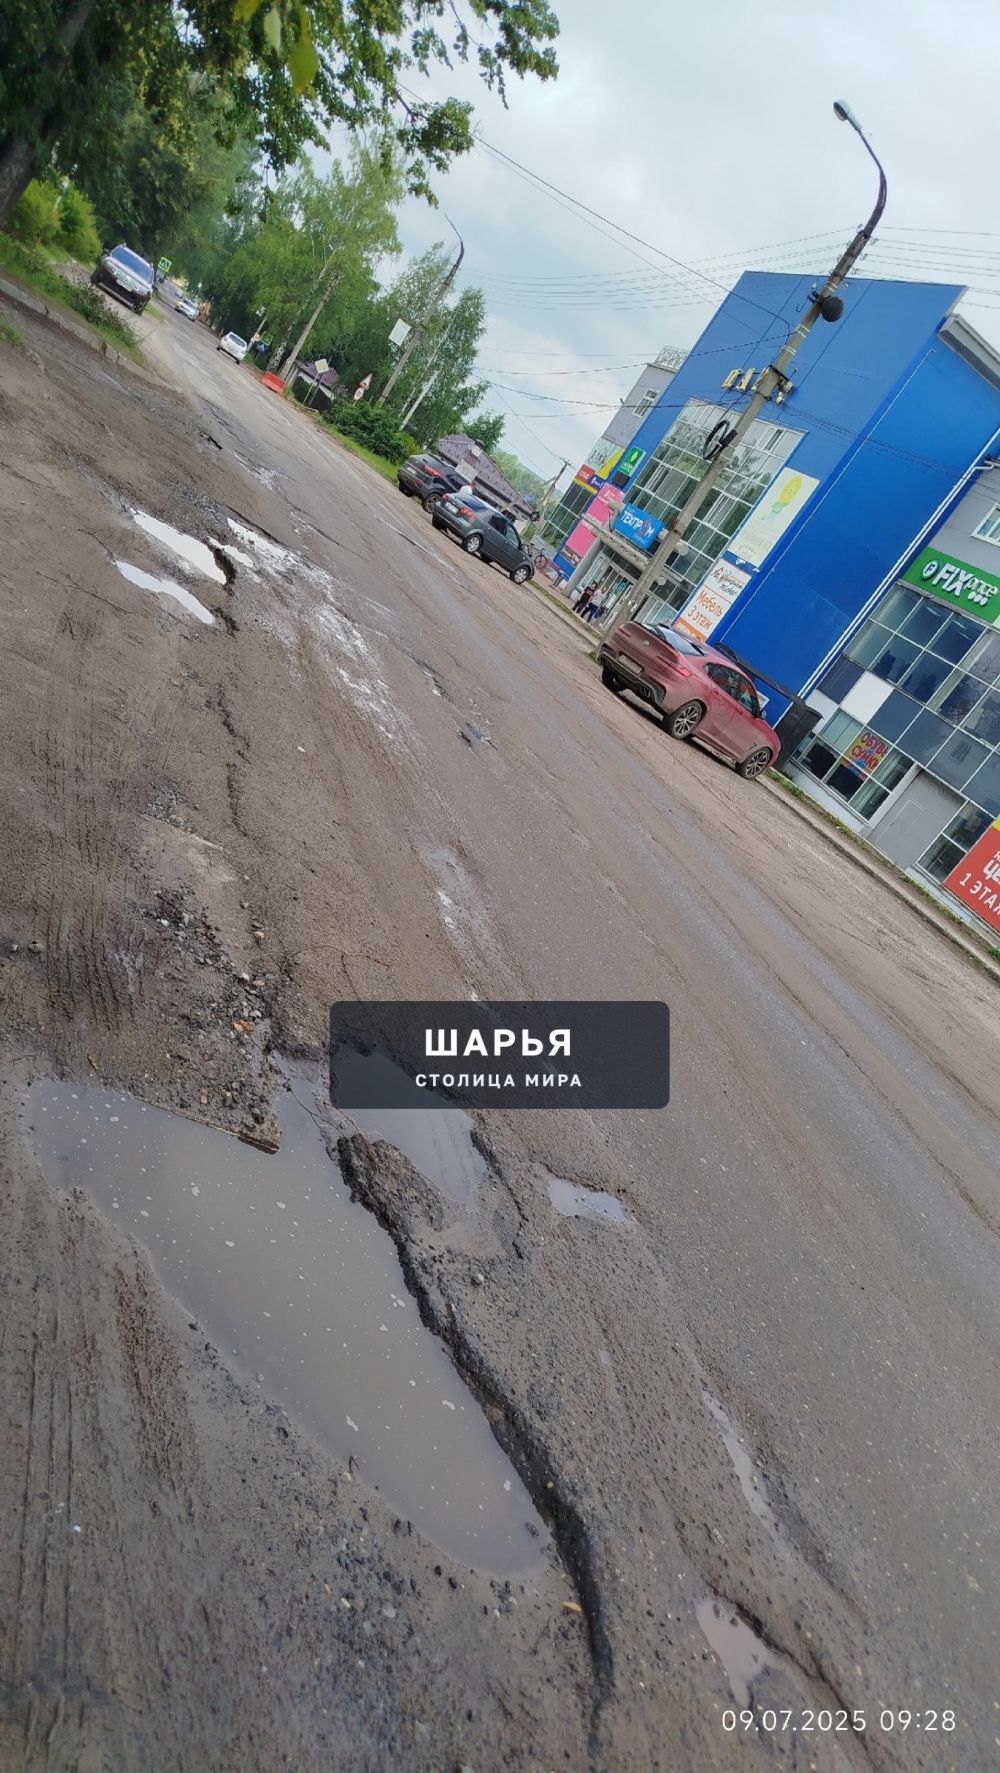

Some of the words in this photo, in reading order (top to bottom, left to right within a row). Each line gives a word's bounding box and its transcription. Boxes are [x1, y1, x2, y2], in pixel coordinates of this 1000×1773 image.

[696, 590, 724, 617] Мебель
[688, 605, 697, 617] 3
[693, 612, 713, 630] этаж
[959, 872, 972, 887] 1
